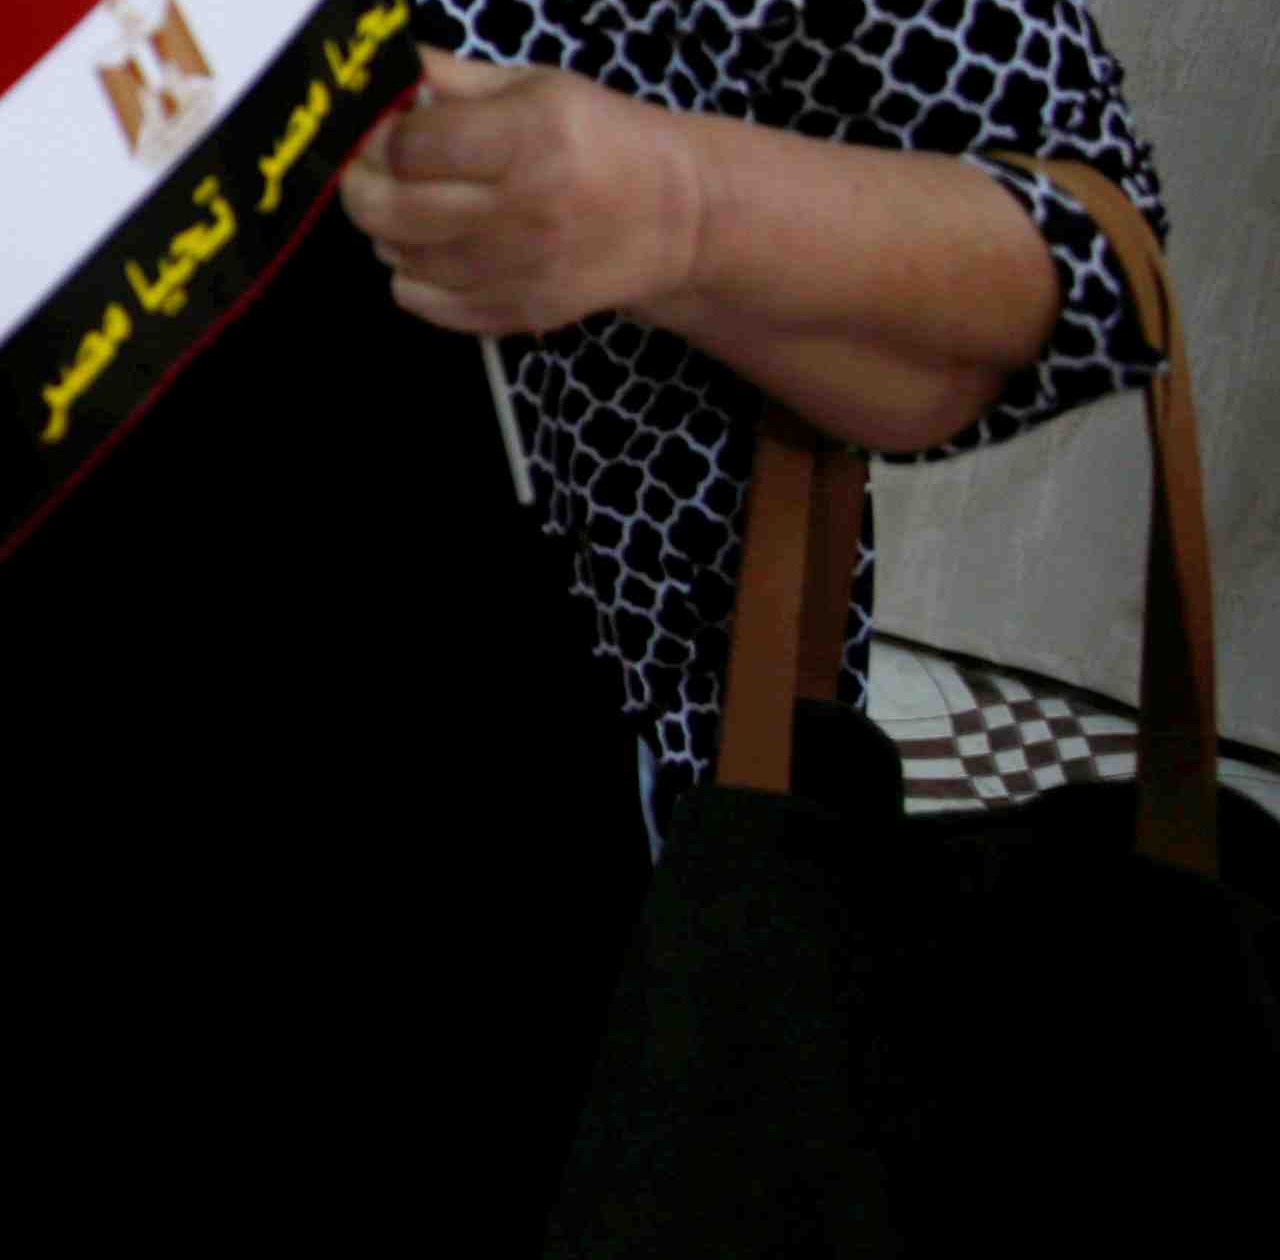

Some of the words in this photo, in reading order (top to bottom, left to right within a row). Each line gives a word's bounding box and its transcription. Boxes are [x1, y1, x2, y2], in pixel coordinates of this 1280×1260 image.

[257, 80, 331, 213] مصر
[124, 174, 237, 316] تحيا
[41, 302, 132, 442] مصر
